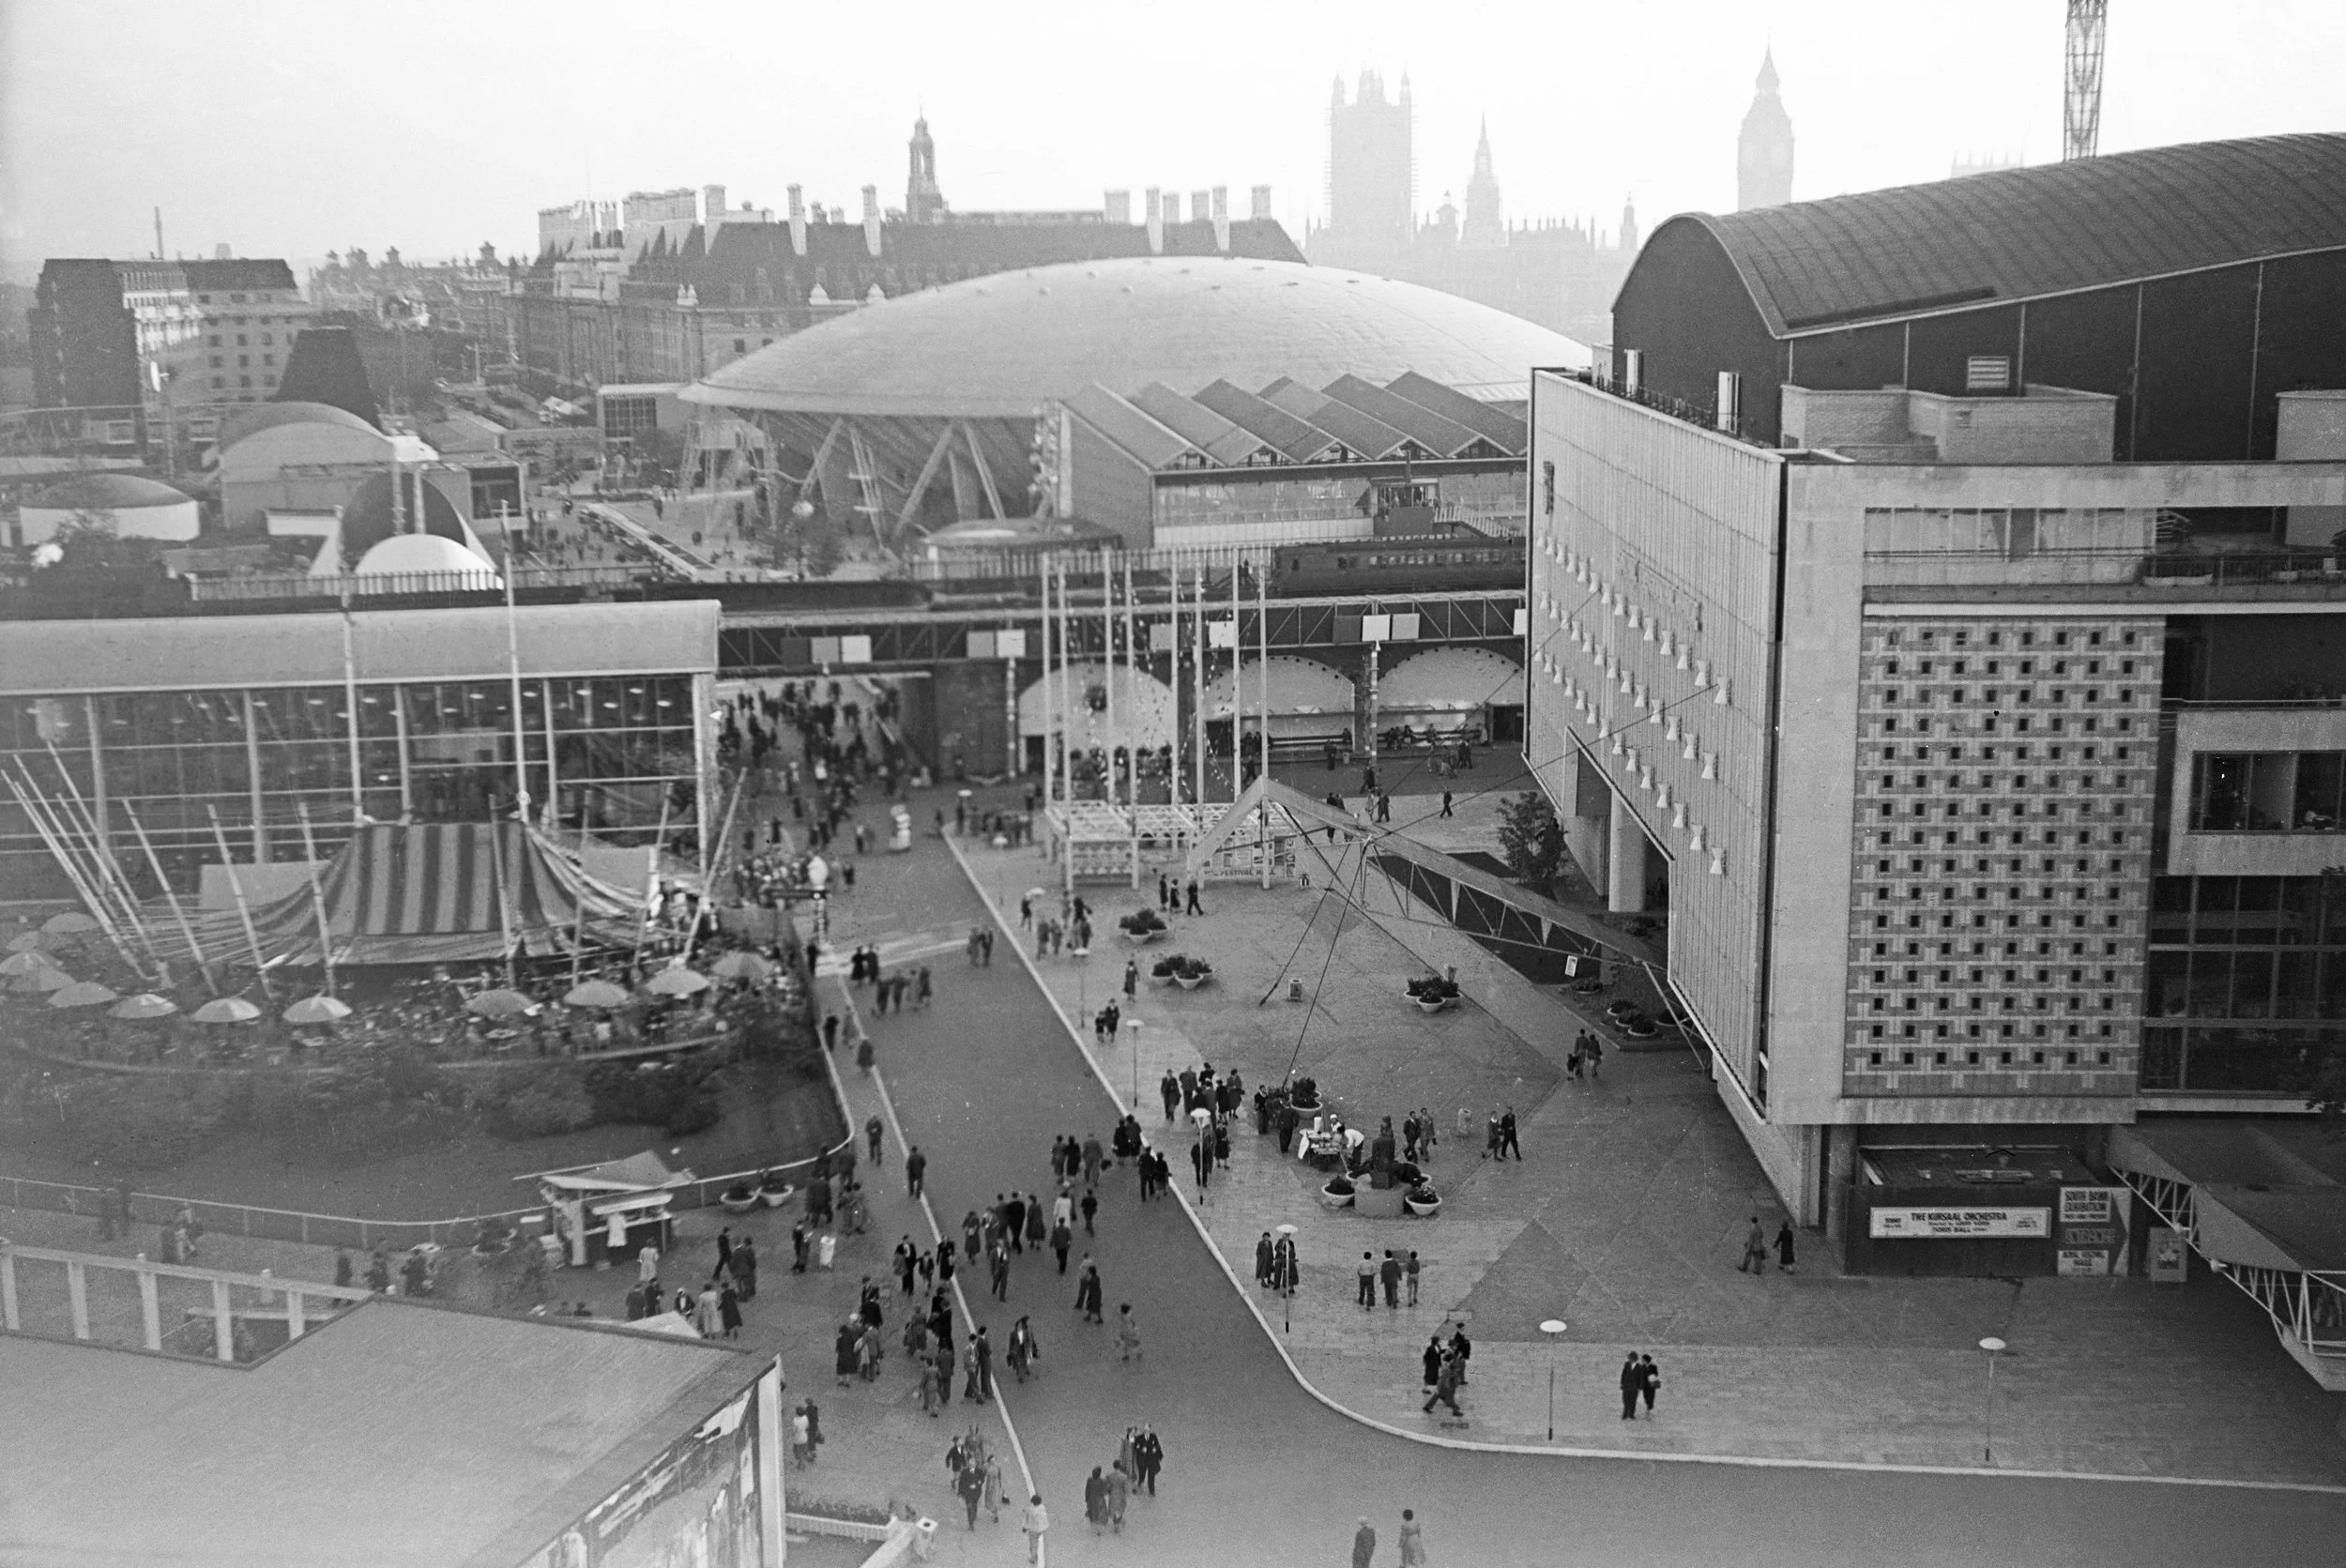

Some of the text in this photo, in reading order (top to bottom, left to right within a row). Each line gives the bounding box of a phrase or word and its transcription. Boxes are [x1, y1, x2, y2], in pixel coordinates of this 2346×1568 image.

[1911, 1212, 2007, 1222] THE KURSAAL ORCHESTRA
